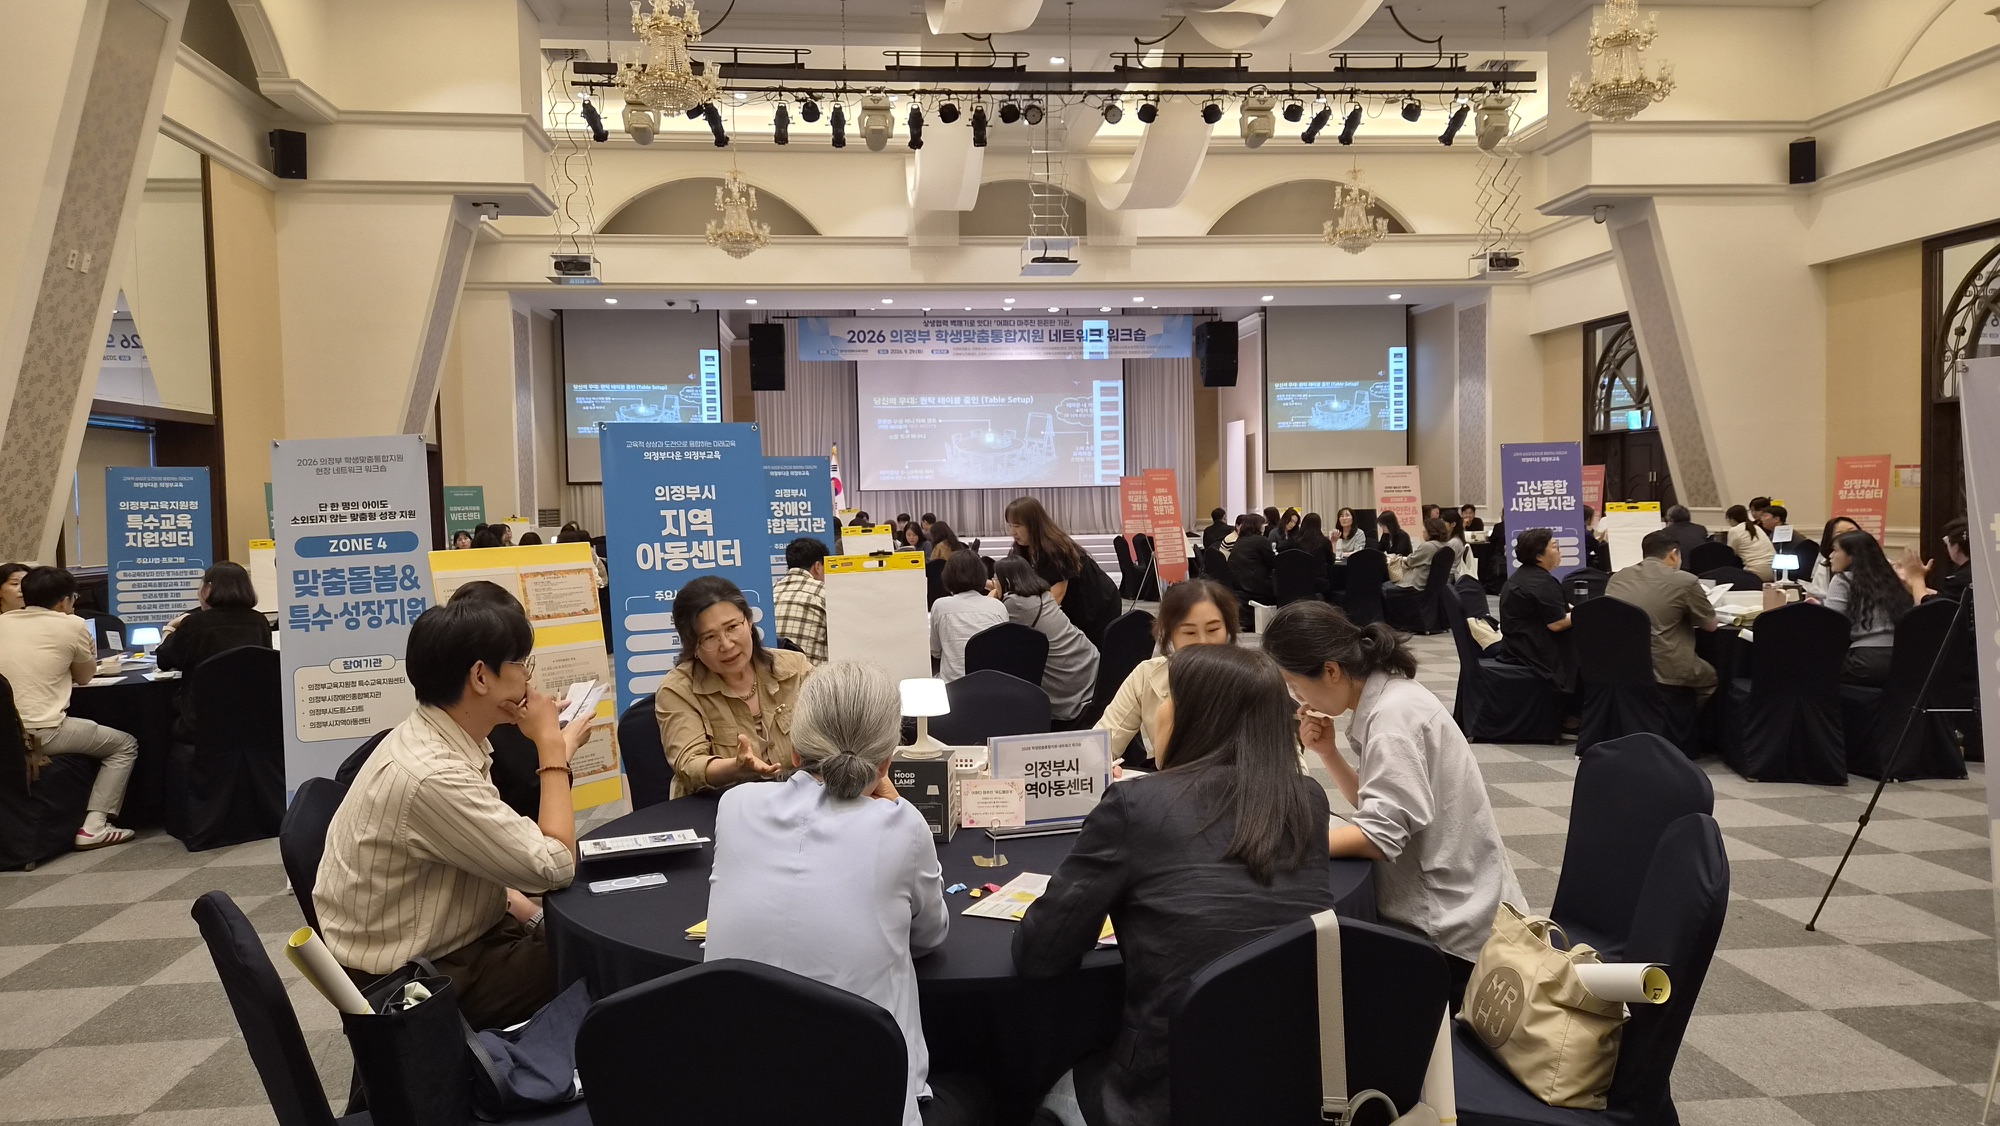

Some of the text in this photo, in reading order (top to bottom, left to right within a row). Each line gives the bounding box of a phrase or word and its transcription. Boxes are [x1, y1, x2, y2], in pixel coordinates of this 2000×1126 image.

[846, 328, 1147, 344] 2026 의정부 학생맞춤통합지원 네트워크 워크숍
[981, 396, 1006, 404] (Table
[1008, 395, 1034, 404] Setup)
[296, 454, 404, 467] 2026 의정부 학생맞춤통합지원
[644, 450, 722, 460] 의정부다운 의정부교육
[316, 464, 387, 476] 현장 네트워크 워크숍
[1516, 479, 1568, 496] 고산종합
[1843, 479, 1880, 489] 의정부시
[654, 485, 716, 501] 의정부시
[775, 489, 806, 498] 의정부시
[1152, 495, 1174, 504] 아동보호
[119, 501, 198, 510] 의정부교육지원청
[318, 500, 389, 512] 단 한 명의 아이도
[770, 501, 812, 517] 장애인
[1510, 496, 1576, 512] 사회복지관
[127, 514, 192, 530] 특수교육
[290, 510, 416, 525] 소외되지 않는 맞춤형 성장 지원
[450, 512, 480, 521] WEE센터
[660, 508, 714, 537] 지역
[125, 531, 194, 548] 지원센터
[329, 537, 388, 553] ZONE 4
[636, 539, 742, 571] 아동센터
[292, 564, 421, 599] 맞춤돌봄&
[288, 597, 426, 632] 특수·성장지원
[342, 658, 382, 670] 참여기관
[308, 677, 406, 691] 의정부교육지원청 특수교육지원센터
[308, 691, 382, 704] 의정부시장애인종합복지관
[309, 705, 364, 716] 의정부시드림스타트
[309, 717, 371, 729] 의정부시지역아동센터
[1024, 758, 1079, 779] 의정부시
[1024, 777, 1094, 799] 역아동센터
[1486, 973, 1518, 1013] MR
